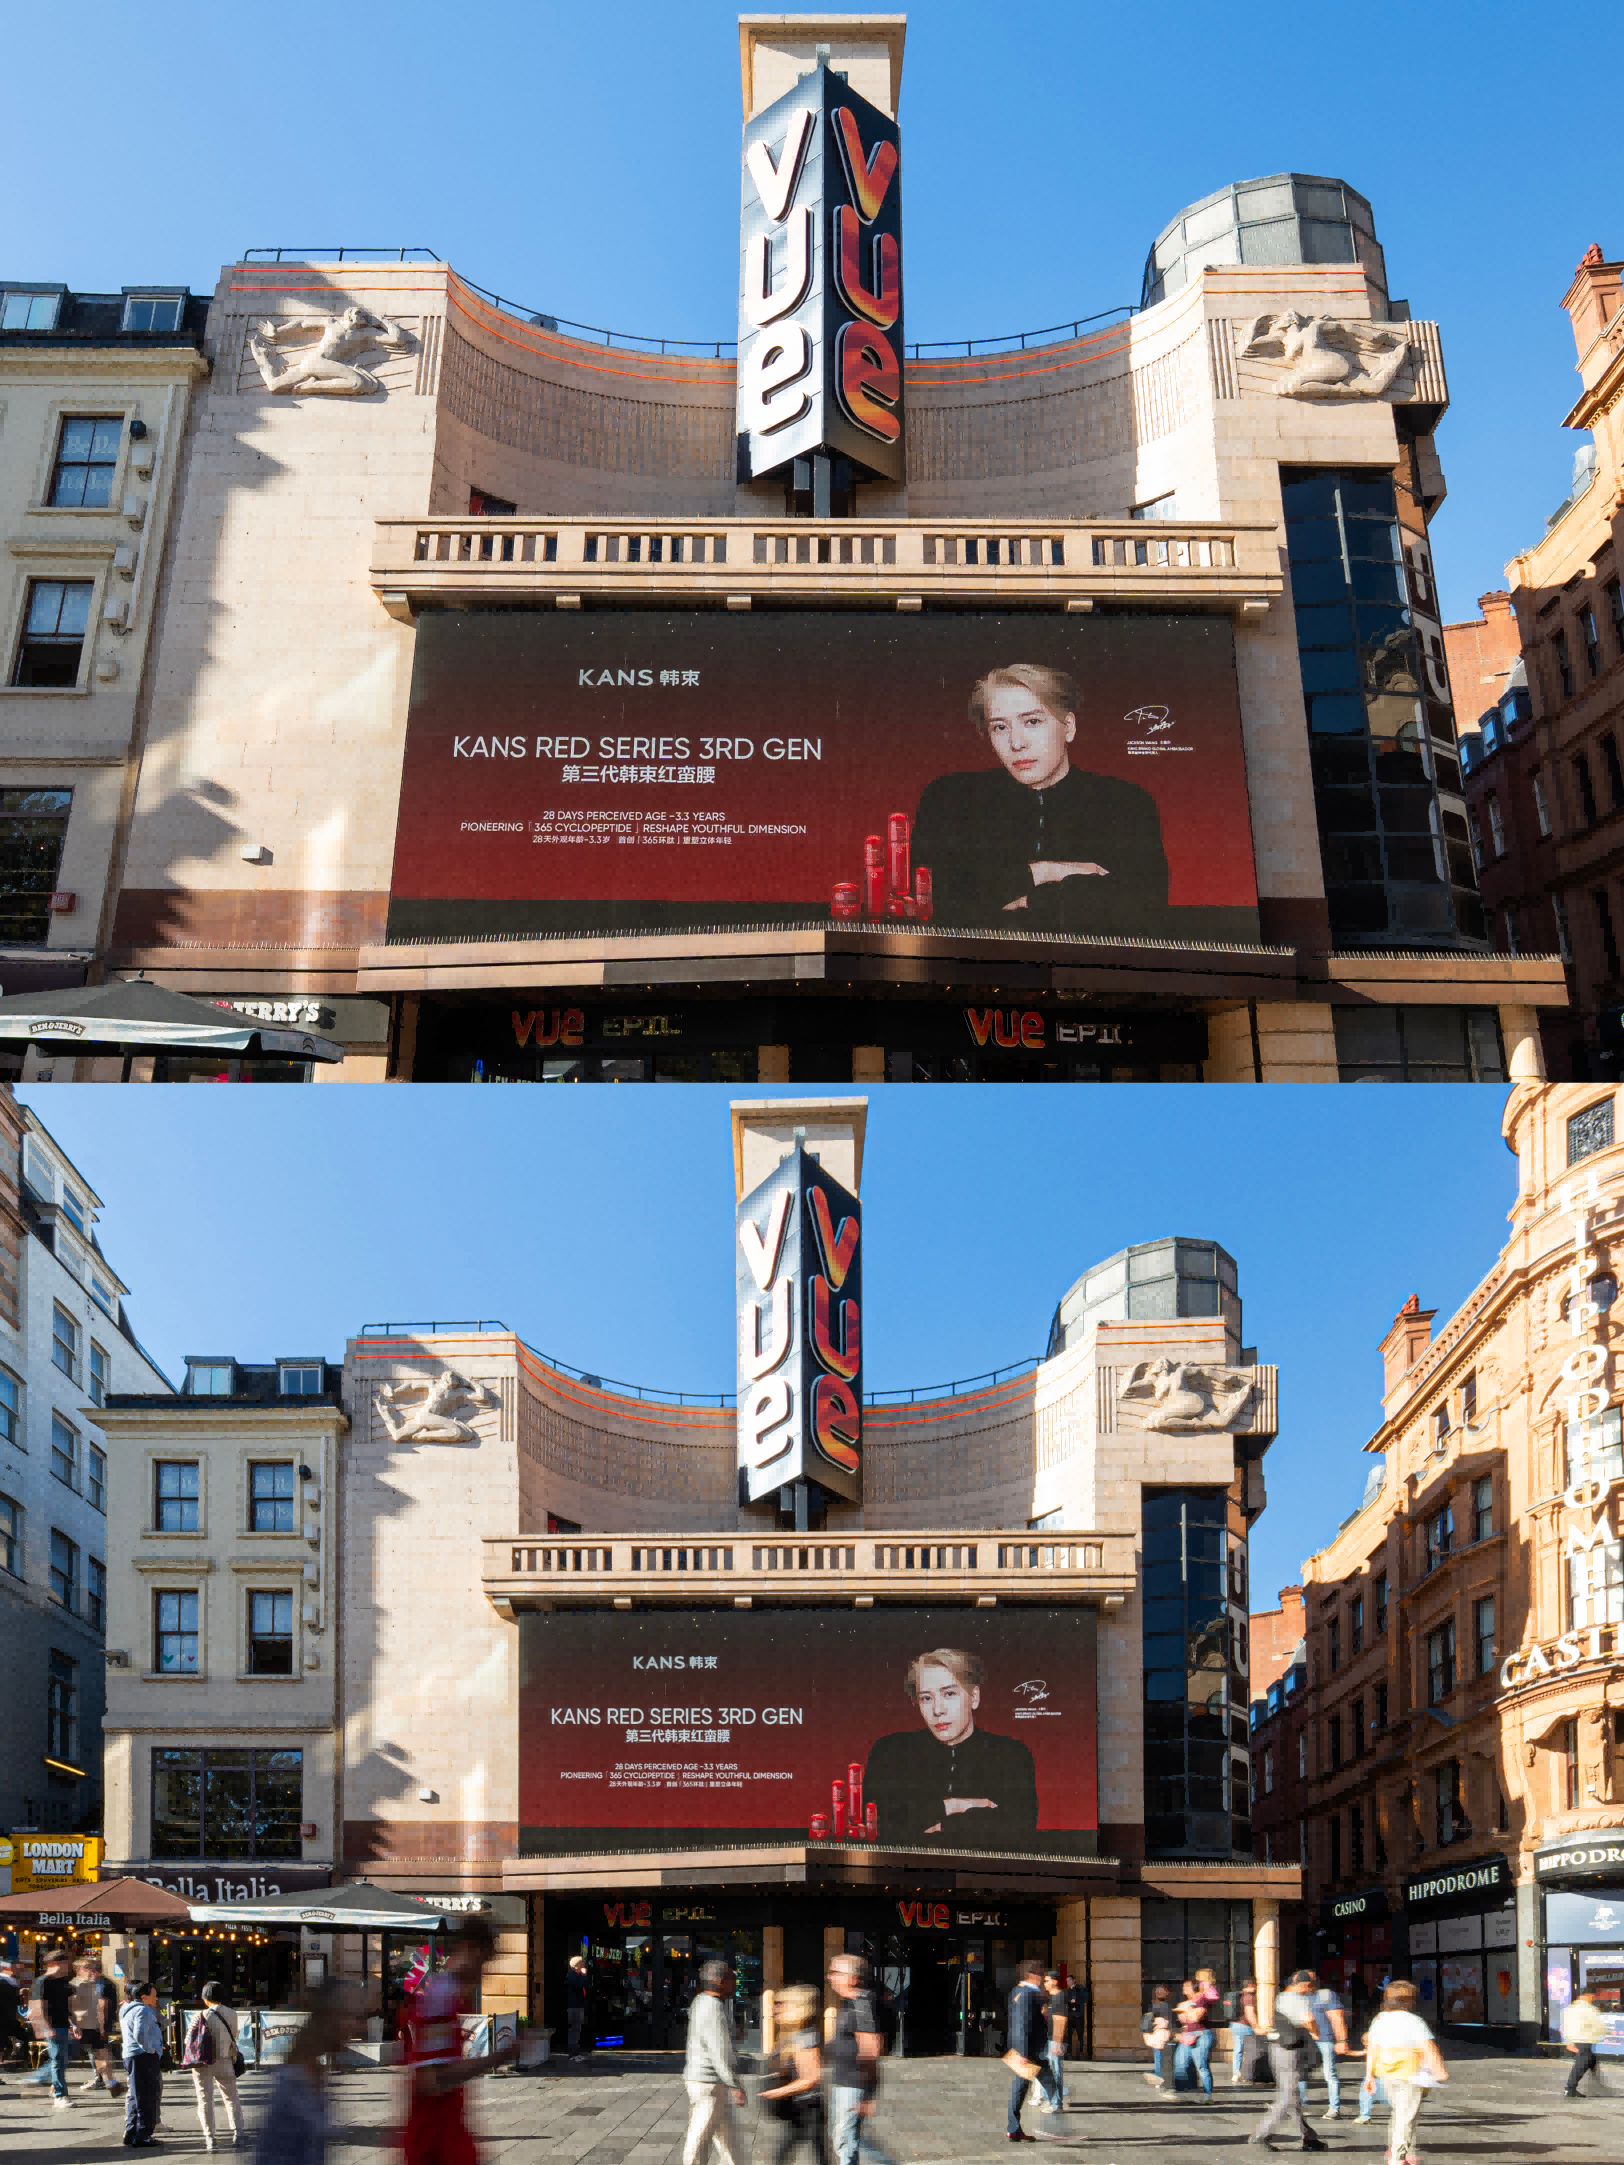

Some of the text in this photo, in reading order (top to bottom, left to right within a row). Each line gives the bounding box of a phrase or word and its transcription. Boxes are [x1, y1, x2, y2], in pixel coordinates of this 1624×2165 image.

[578, 668, 701, 687] KANS 韩束
[453, 735, 822, 761] KANS RED SERIES 3RD GEN
[561, 764, 716, 784] 第三代韩束红蛮腰
[542, 810, 556, 820] 28
[557, 810, 585, 820] DAYS
[586, 811, 643, 821] PERCEIVED
[645, 811, 667, 821] AGE
[692, 811, 726, 821] YEARS
[460, 822, 524, 832] PIONEERING
[642, 824, 690, 833] RESHAPE
[691, 824, 746, 834] YOUTHFUL
[748, 824, 807, 834] DIMENSION
[1559, 1171, 1614, 1602] HIPPODROME
[633, 1655, 718, 1670] KANS 韩束
[1500, 1621, 1624, 1688] CASI
[551, 1707, 803, 1725] KANS RED SERIES 3RD GEN
[625, 1728, 731, 1744] 第三代韩束红蛮腰
[614, 1762, 624, 1771] 28
[624, 1762, 643, 1771] DAYS
[643, 1762, 683, 1771] PERCEIVED
[683, 1762, 699, 1771] AGE
[715, 1762, 739, 1771] YEARS
[560, 1771, 604, 1780] PIONEERING
[682, 1771, 714, 1780] RESHAPE
[714, 1771, 752, 1780] YOUTHFUL
[752, 1771, 793, 1780] DIMENSION
[23, 1842, 84, 1858] LONDON
[32, 1859, 75, 1875] MART
[1409, 1866, 1500, 1900] HIPPODROME
[1334, 1898, 1366, 1917] CASINO
[39, 1912, 110, 1926] Bella Italia
